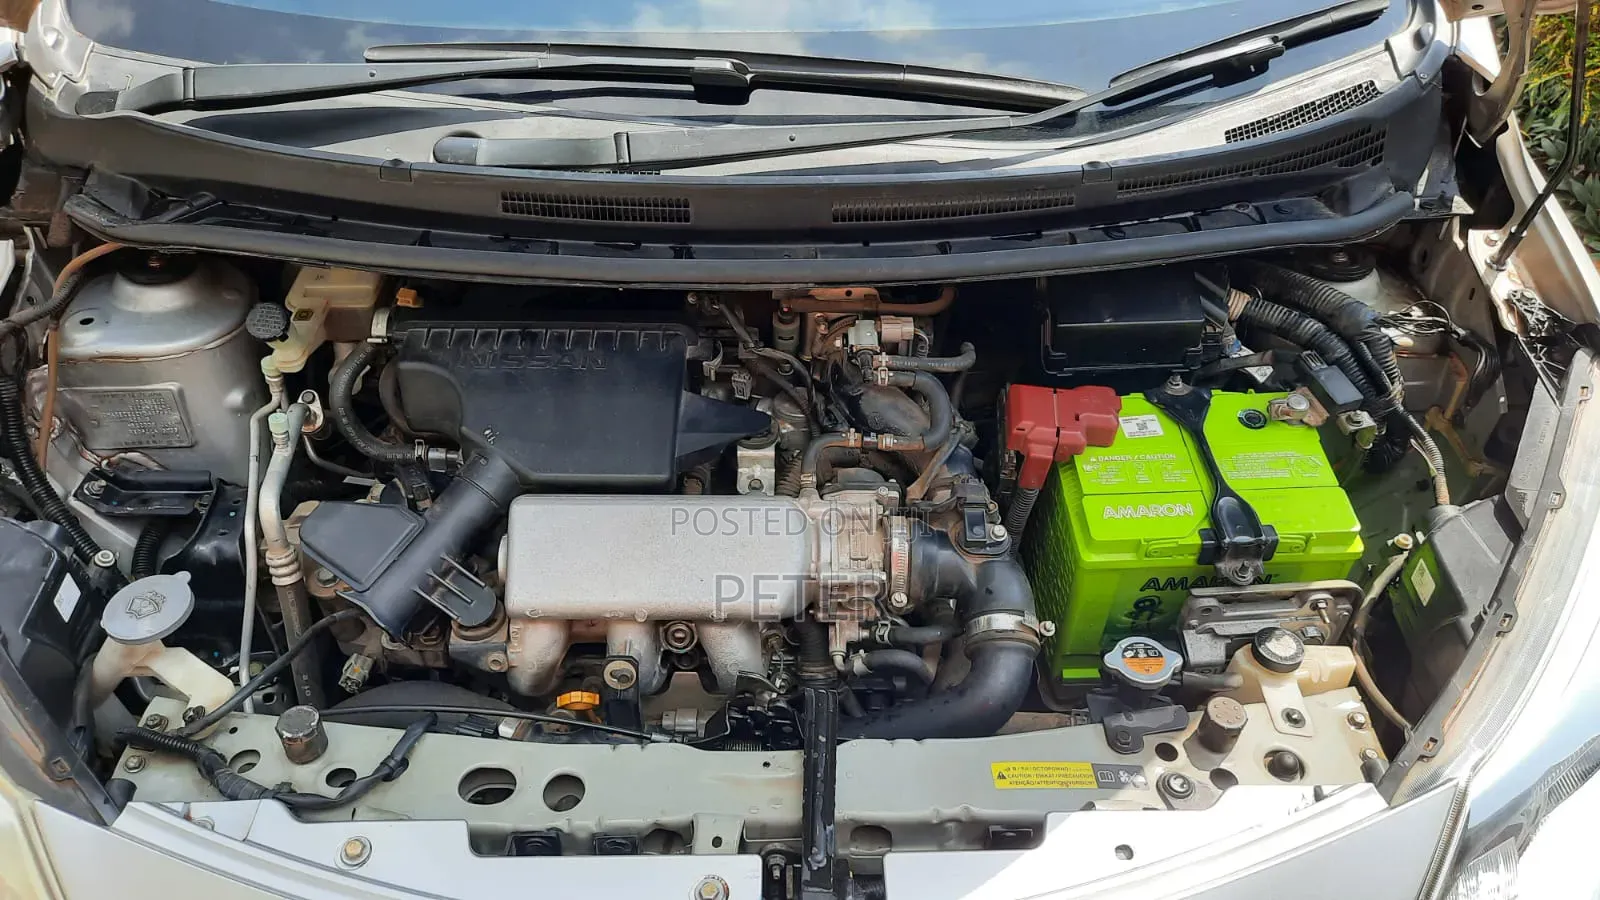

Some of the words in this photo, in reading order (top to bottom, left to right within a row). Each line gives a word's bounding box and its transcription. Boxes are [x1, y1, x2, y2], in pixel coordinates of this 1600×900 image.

[456, 351, 607, 370] NISSAN
[1139, 453, 1177, 461] CAUTION
[1103, 503, 1194, 520] AMARON
